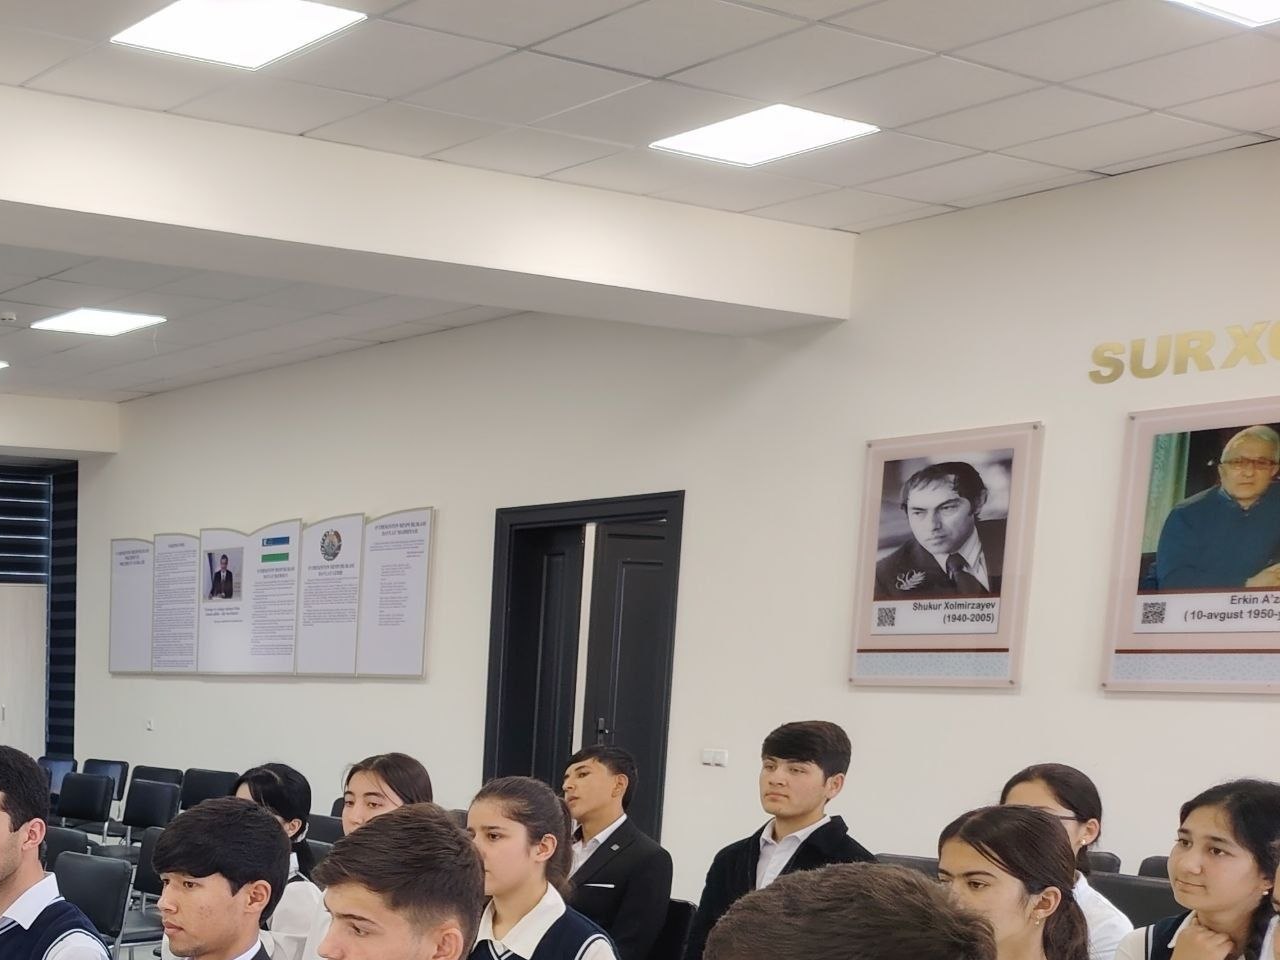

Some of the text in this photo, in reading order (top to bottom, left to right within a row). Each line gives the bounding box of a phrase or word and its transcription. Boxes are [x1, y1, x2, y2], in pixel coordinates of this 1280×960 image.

[1230, 595, 1259, 605] Erkin
[912, 601, 996, 611] Shukur Xolmirzayev
[943, 613, 994, 624] (1940-2005)
